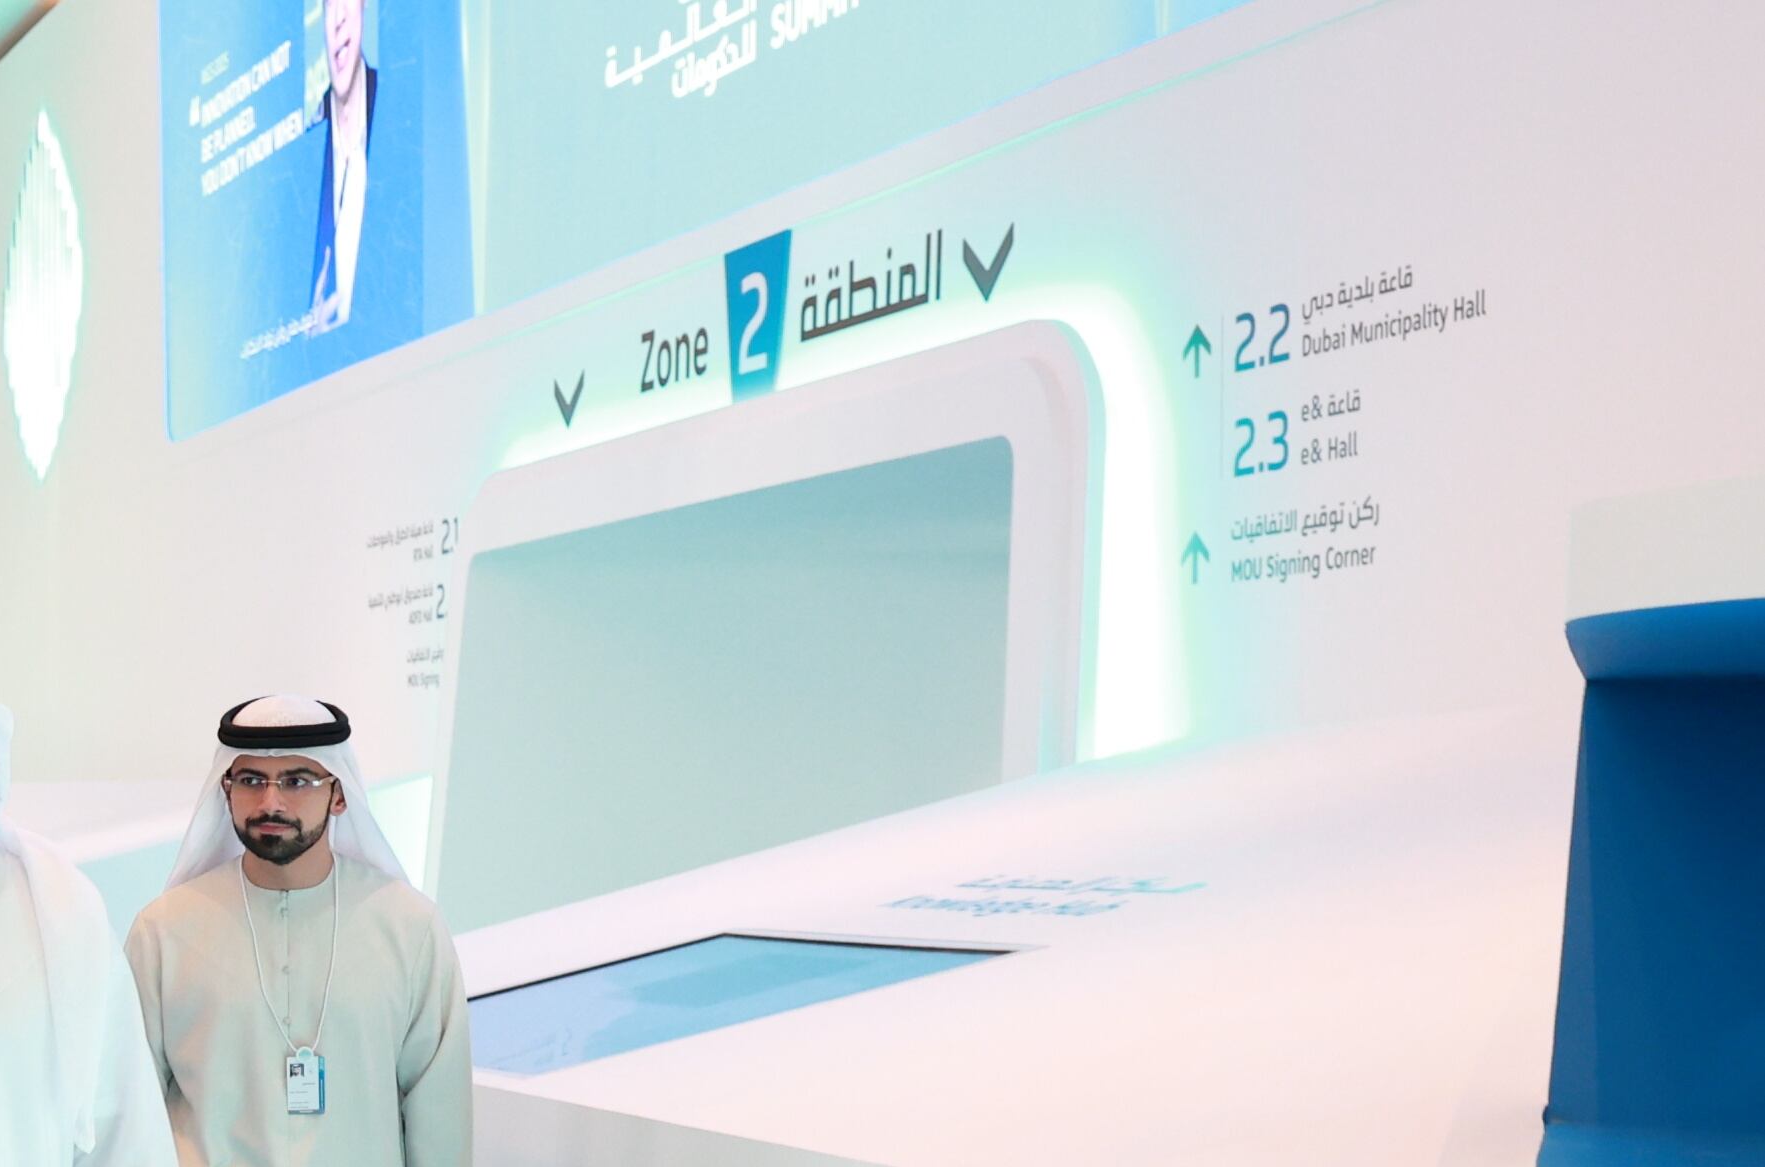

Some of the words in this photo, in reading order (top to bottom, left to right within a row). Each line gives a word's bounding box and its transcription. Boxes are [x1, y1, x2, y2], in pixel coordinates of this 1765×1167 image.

[800, 229, 942, 342] المنطقة
[1337, 276, 1375, 308] بلدية
[1379, 265, 1413, 295] قاعة
[1302, 292, 1334, 325] دبي
[1302, 325, 1346, 357] Dubai
[1350, 303, 1448, 346] Municipality
[1453, 290, 1486, 322] Hall
[640, 327, 708, 393] Zone
[738, 272, 768, 376] 2
[1234, 304, 1290, 372] 2.2
[1301, 395, 1322, 422] e&
[1328, 389, 1361, 416] قاعة
[1234, 410, 1288, 477] 2.3
[1301, 438, 1322, 465] e&
[1328, 431, 1358, 460] Hall
[1301, 502, 1345, 536] توقيع
[1349, 495, 1379, 530] ركن
[1231, 557, 1262, 582] MOU
[1266, 549, 1321, 583] Signing
[1325, 547, 1376, 570] Corner
